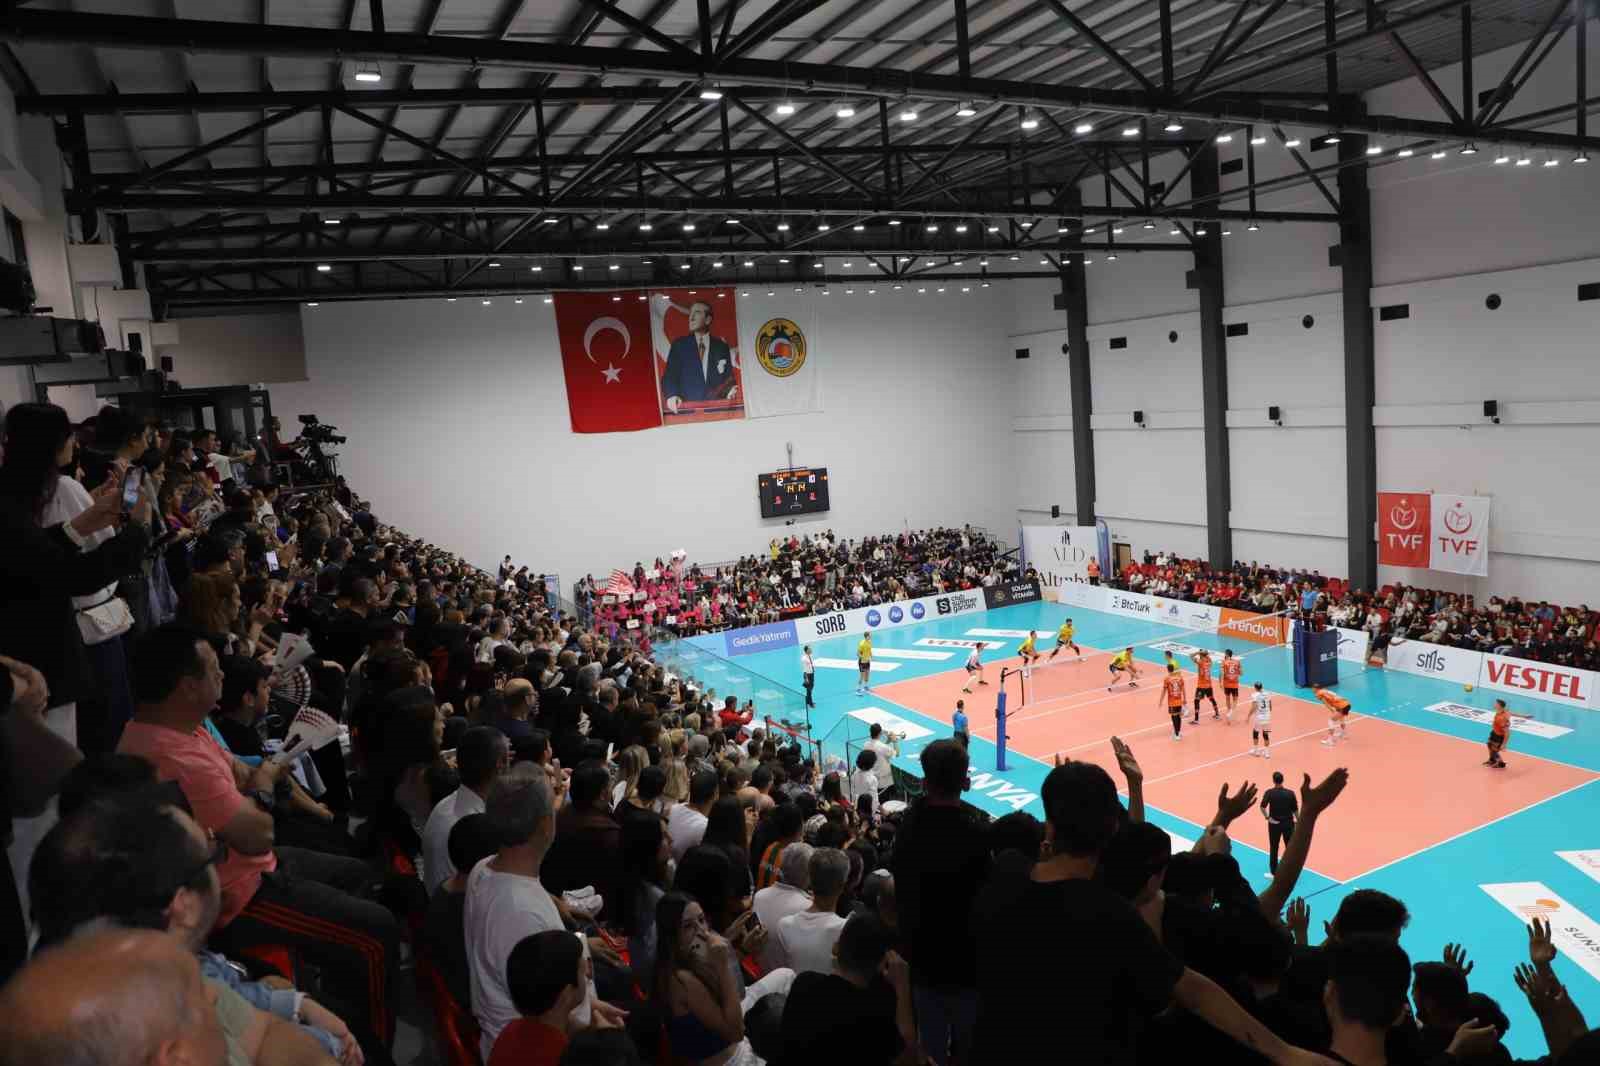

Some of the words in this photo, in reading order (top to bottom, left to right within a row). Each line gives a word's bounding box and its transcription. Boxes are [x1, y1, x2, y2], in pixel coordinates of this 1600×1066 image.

[1386, 533, 1424, 551] TVF
[1438, 536, 1479, 556] TVF
[1121, 599, 1150, 613] BtcTurk
[815, 614, 846, 635] SORB
[1228, 618, 1278, 639] trendyol
[1487, 660, 1586, 701] VESTEL
